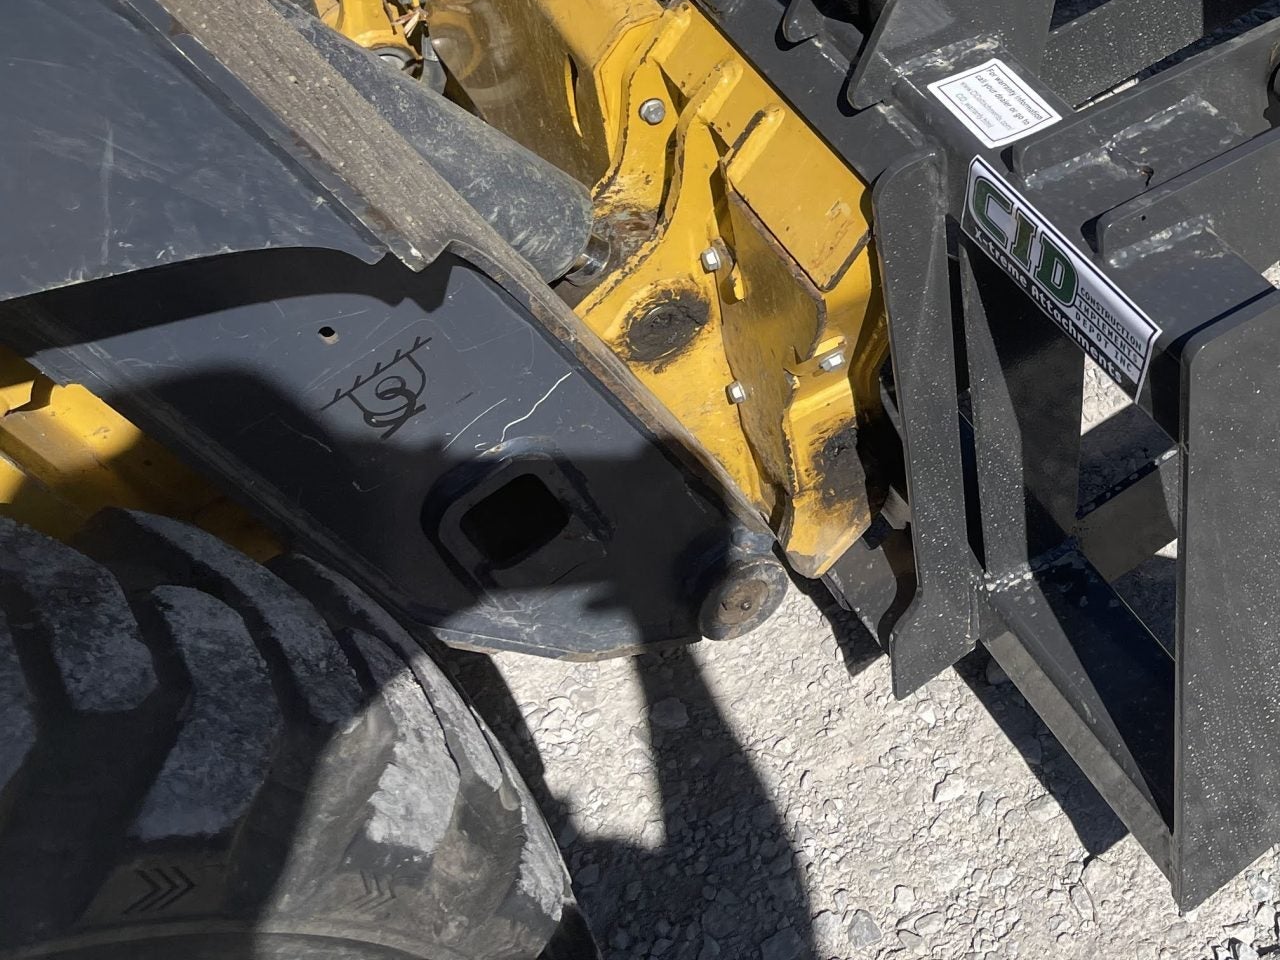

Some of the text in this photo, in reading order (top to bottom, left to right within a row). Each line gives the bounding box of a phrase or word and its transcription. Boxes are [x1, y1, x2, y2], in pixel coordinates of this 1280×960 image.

[975, 75, 986, 84] call
[983, 83, 997, 94] your
[995, 93, 1012, 108] dealer
[987, 69, 1043, 120] For warranty information
[971, 175, 1079, 307] CID
[1031, 284, 1123, 384] Attachments
[1075, 311, 1110, 349] DEPOT
[1078, 299, 1138, 363] IMPLEMENTS
[1080, 287, 1142, 350] CONSTRUCTION
